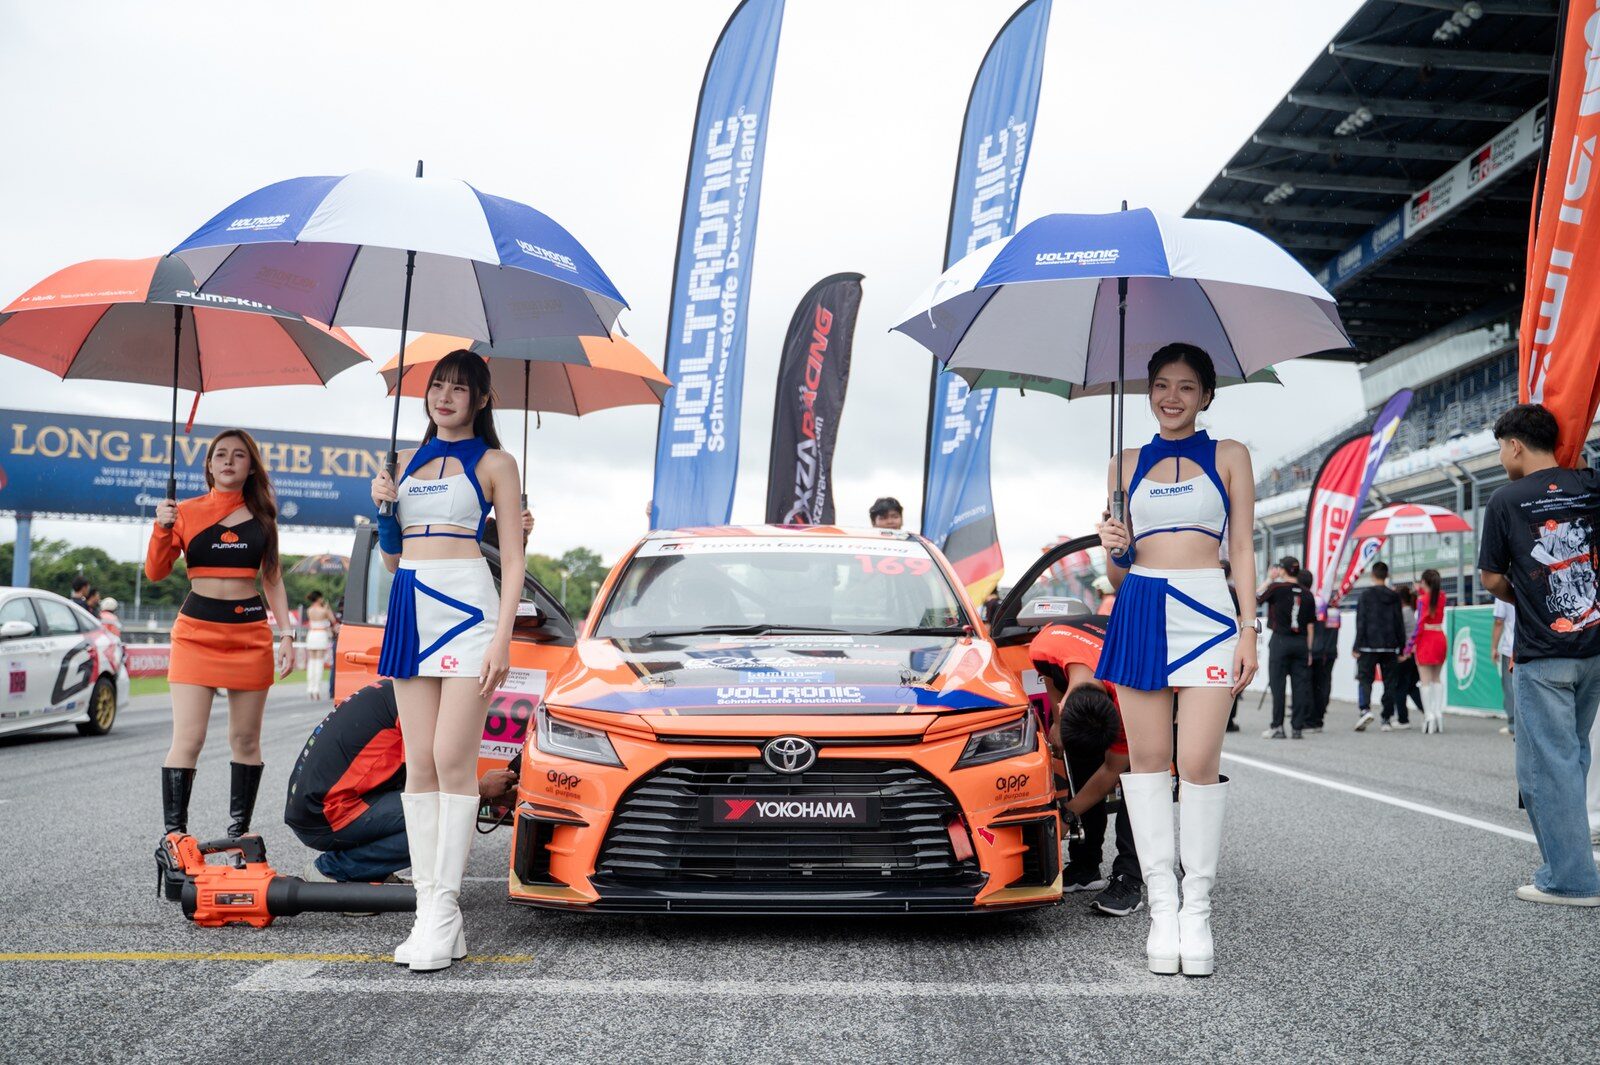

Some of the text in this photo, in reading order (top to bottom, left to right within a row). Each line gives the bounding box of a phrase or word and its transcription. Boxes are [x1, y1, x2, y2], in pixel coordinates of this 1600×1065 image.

[1035, 249, 1119, 261] VOLTRONIC
[672, 116, 739, 457] VOLTRONIC
[707, 113, 757, 452] Schmierstoffe Deutschland
[11, 423, 131, 463] LONG
[319, 446, 390, 478] KIN
[409, 484, 449, 493] VOLTRONIC
[1150, 484, 1193, 495] VOLTRONIC
[854, 555, 932, 576] 169
[717, 686, 861, 699] VOLTRONIC
[484, 696, 534, 739] 69
[755, 801, 856, 819] YOKOHAMA
